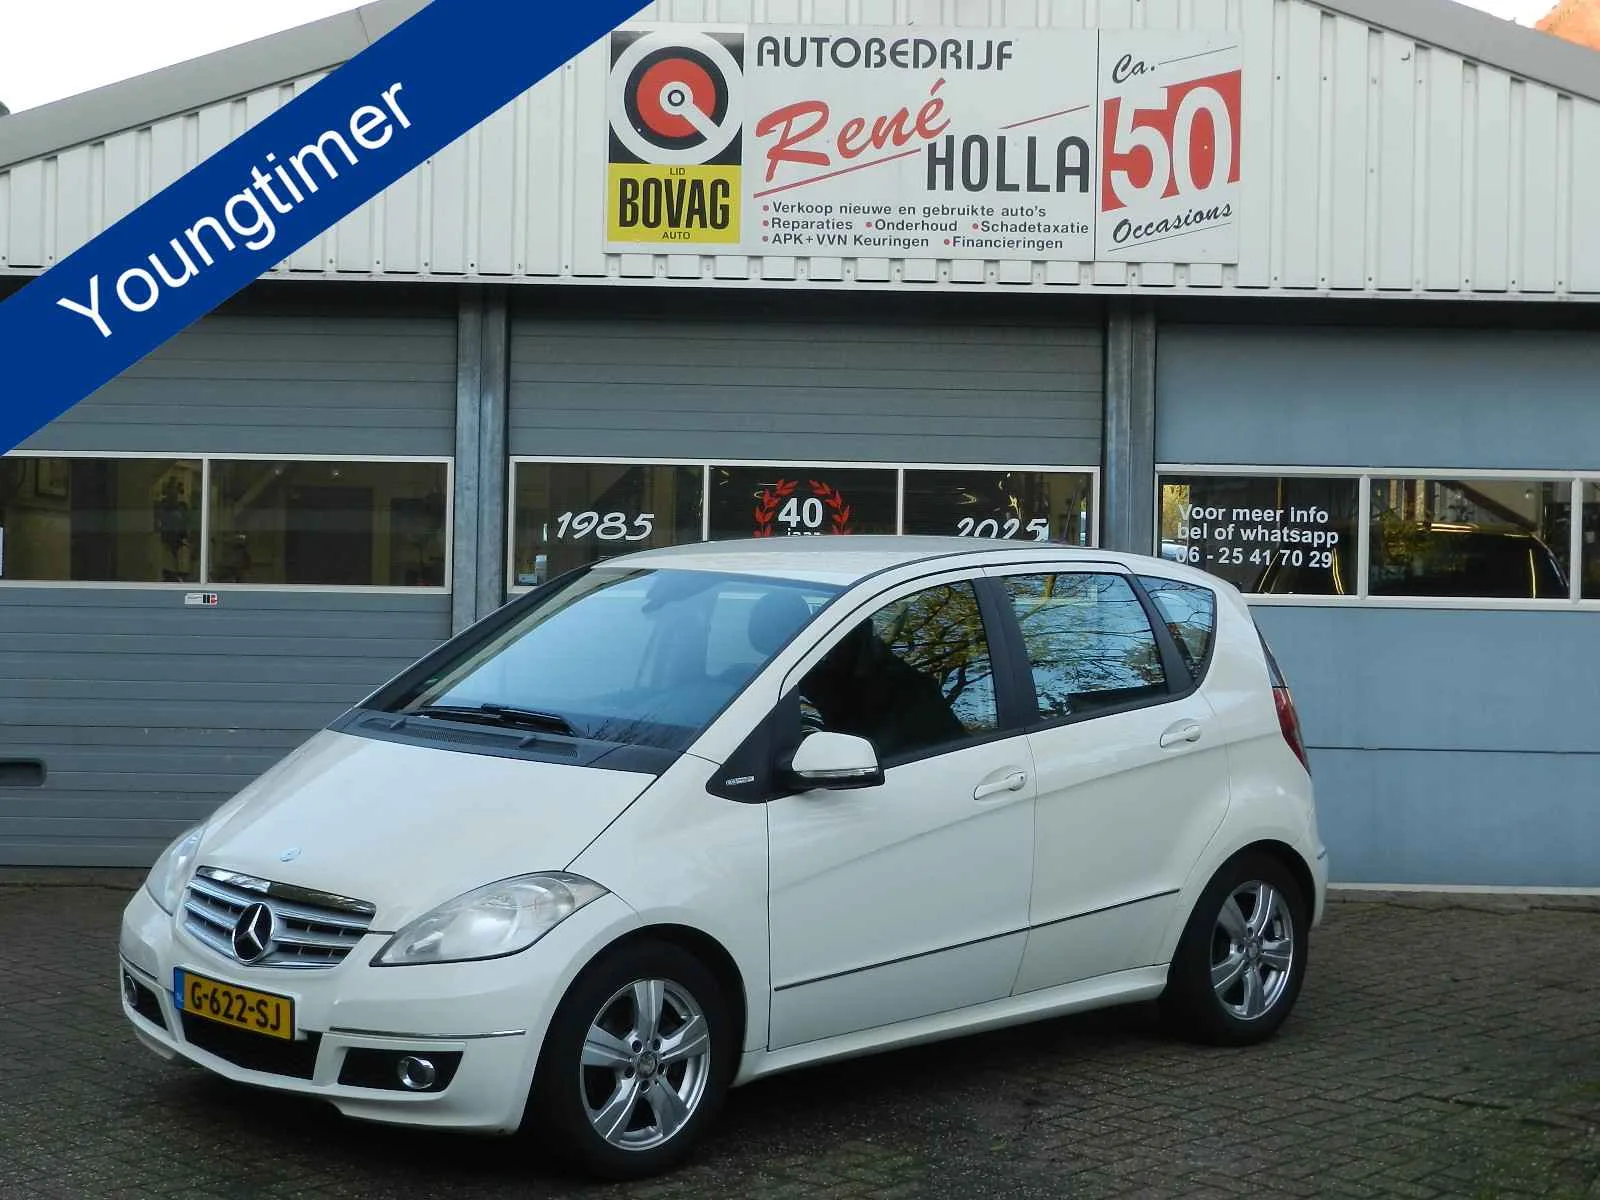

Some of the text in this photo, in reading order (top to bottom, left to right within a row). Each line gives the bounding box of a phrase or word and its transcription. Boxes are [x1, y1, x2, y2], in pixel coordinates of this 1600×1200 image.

[757, 36, 1013, 70] AUTOBEDRIJF
[1111, 54, 1156, 84] Ca.
[755, 77, 951, 183] René
[1110, 86, 1233, 209] 50
[669, 167, 686, 176] LID
[927, 134, 1090, 193] HOLLA
[618, 177, 730, 230] BOVAG
[772, 201, 1046, 218] Verkoop nieuwe en gebruikte auto's
[662, 230, 691, 241] AUTO
[771, 217, 1089, 234] Reparaties Onderhoud Schadetaxatie
[1112, 203, 1233, 244] Occasions
[853, 234, 929, 249] Keuringen
[952, 235, 1063, 251] Financieringen
[556, 511, 655, 541] 1985
[778, 497, 823, 528] 40
[1178, 503, 1226, 521] Voor
[1232, 508, 1284, 522] meer
[957, 517, 1049, 542] 2025
[1177, 522, 1339, 549] bel of whatsapp
[1175, 545, 1200, 563] 06
[1218, 546, 1244, 565] 25
[1249, 548, 1271, 566] 41
[1279, 549, 1303, 566] 70
[1308, 551, 1333, 568] 29
[191, 981, 281, 1031] G-622-SJ
